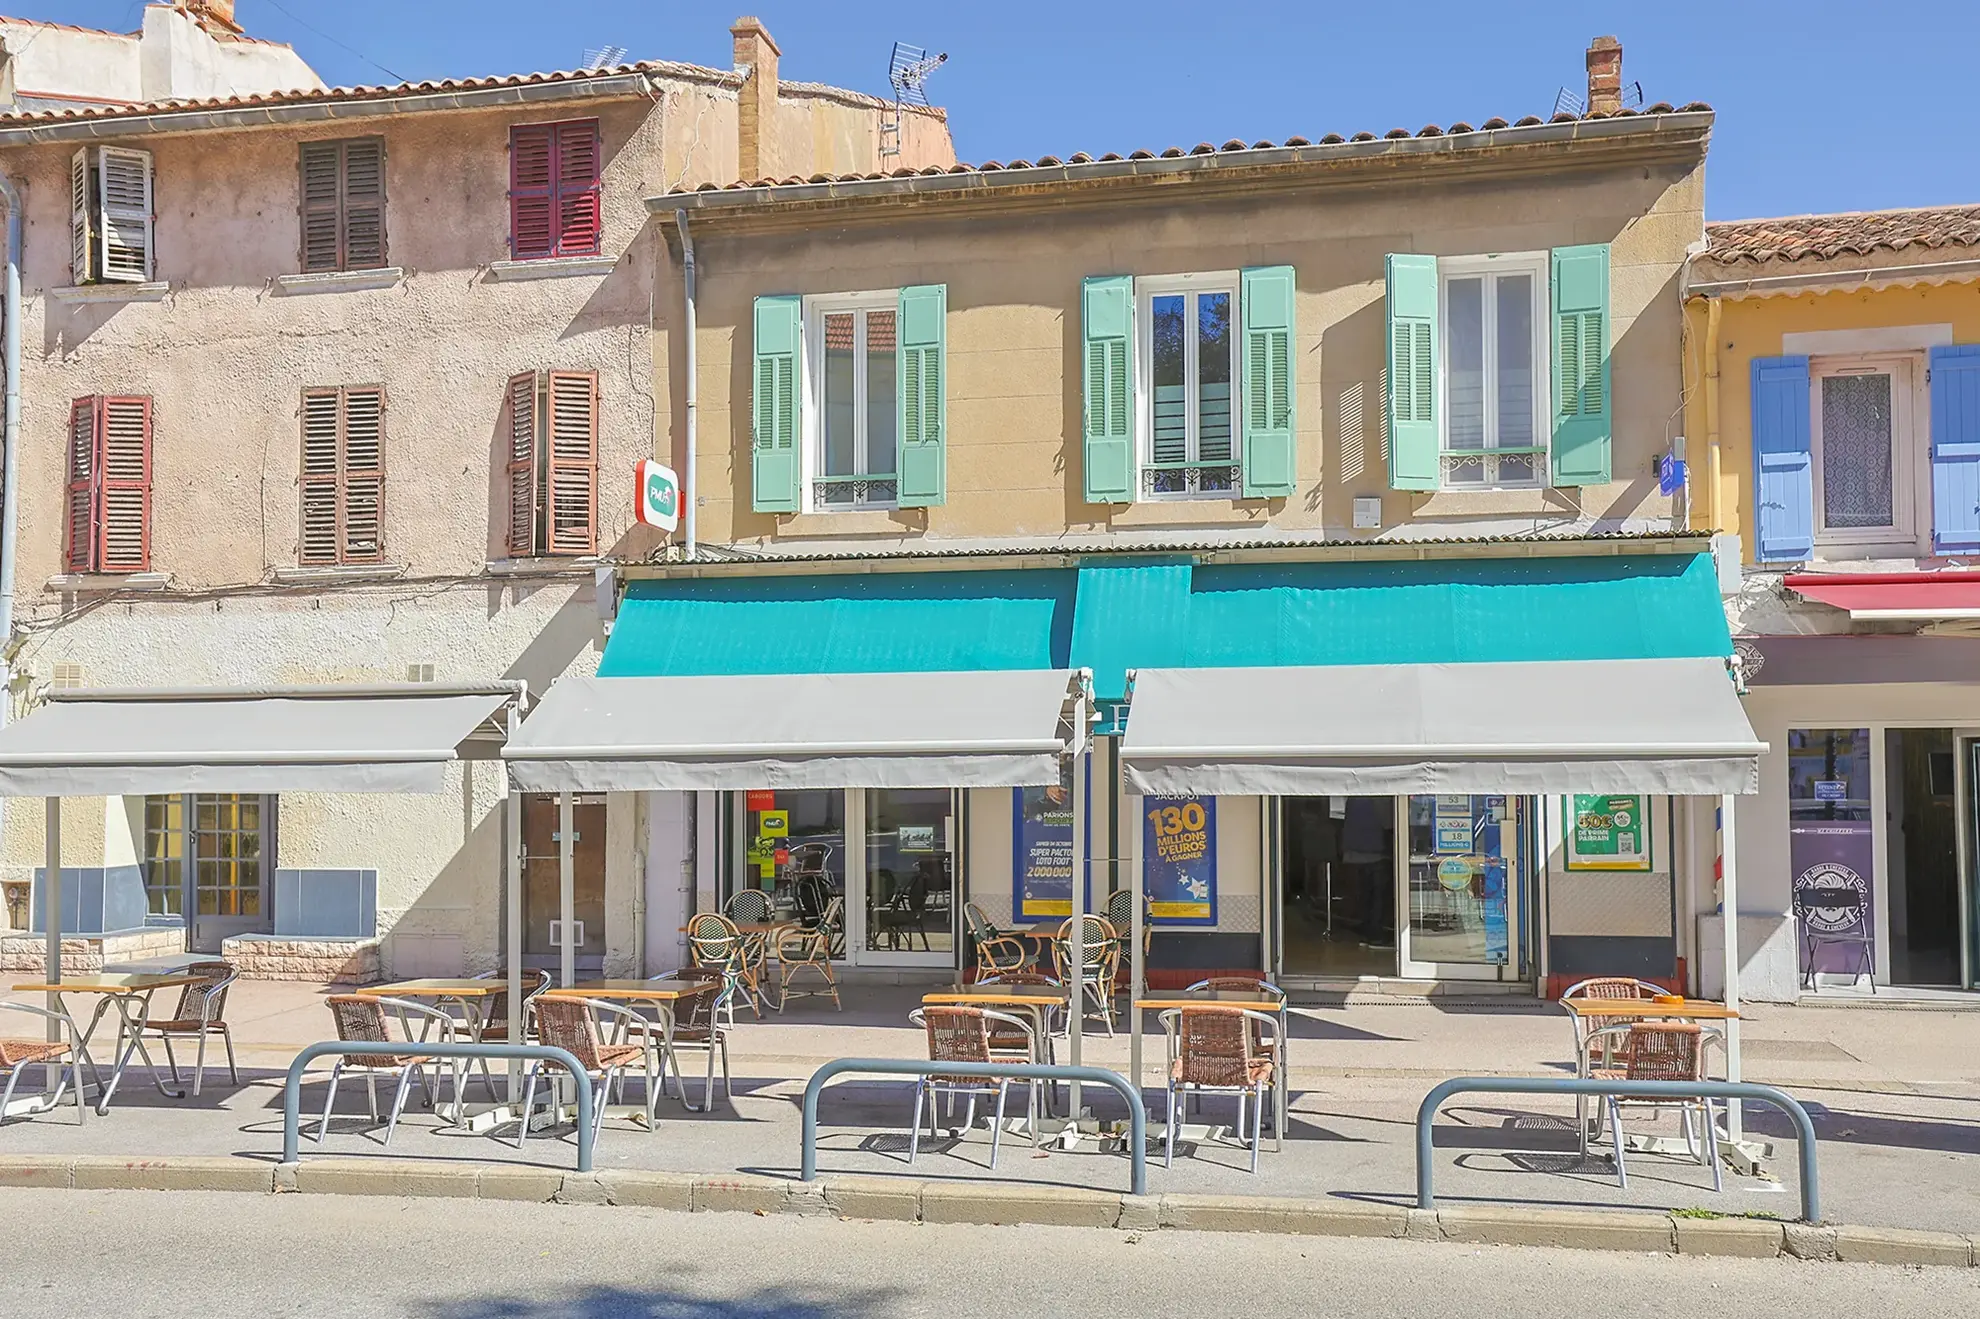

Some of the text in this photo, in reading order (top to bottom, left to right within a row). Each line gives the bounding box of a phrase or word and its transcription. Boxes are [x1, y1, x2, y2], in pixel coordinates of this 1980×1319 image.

[1448, 796, 1459, 804] 53
[1148, 802, 1206, 837] 130
[1157, 831, 1206, 847] MILLIONS
[1029, 848, 1073, 857] SUPER PACTO
[1158, 840, 1206, 857] D'EUROS
[1036, 857, 1071, 865] LOTO FOOT
[1172, 851, 1203, 862] GAGNER
